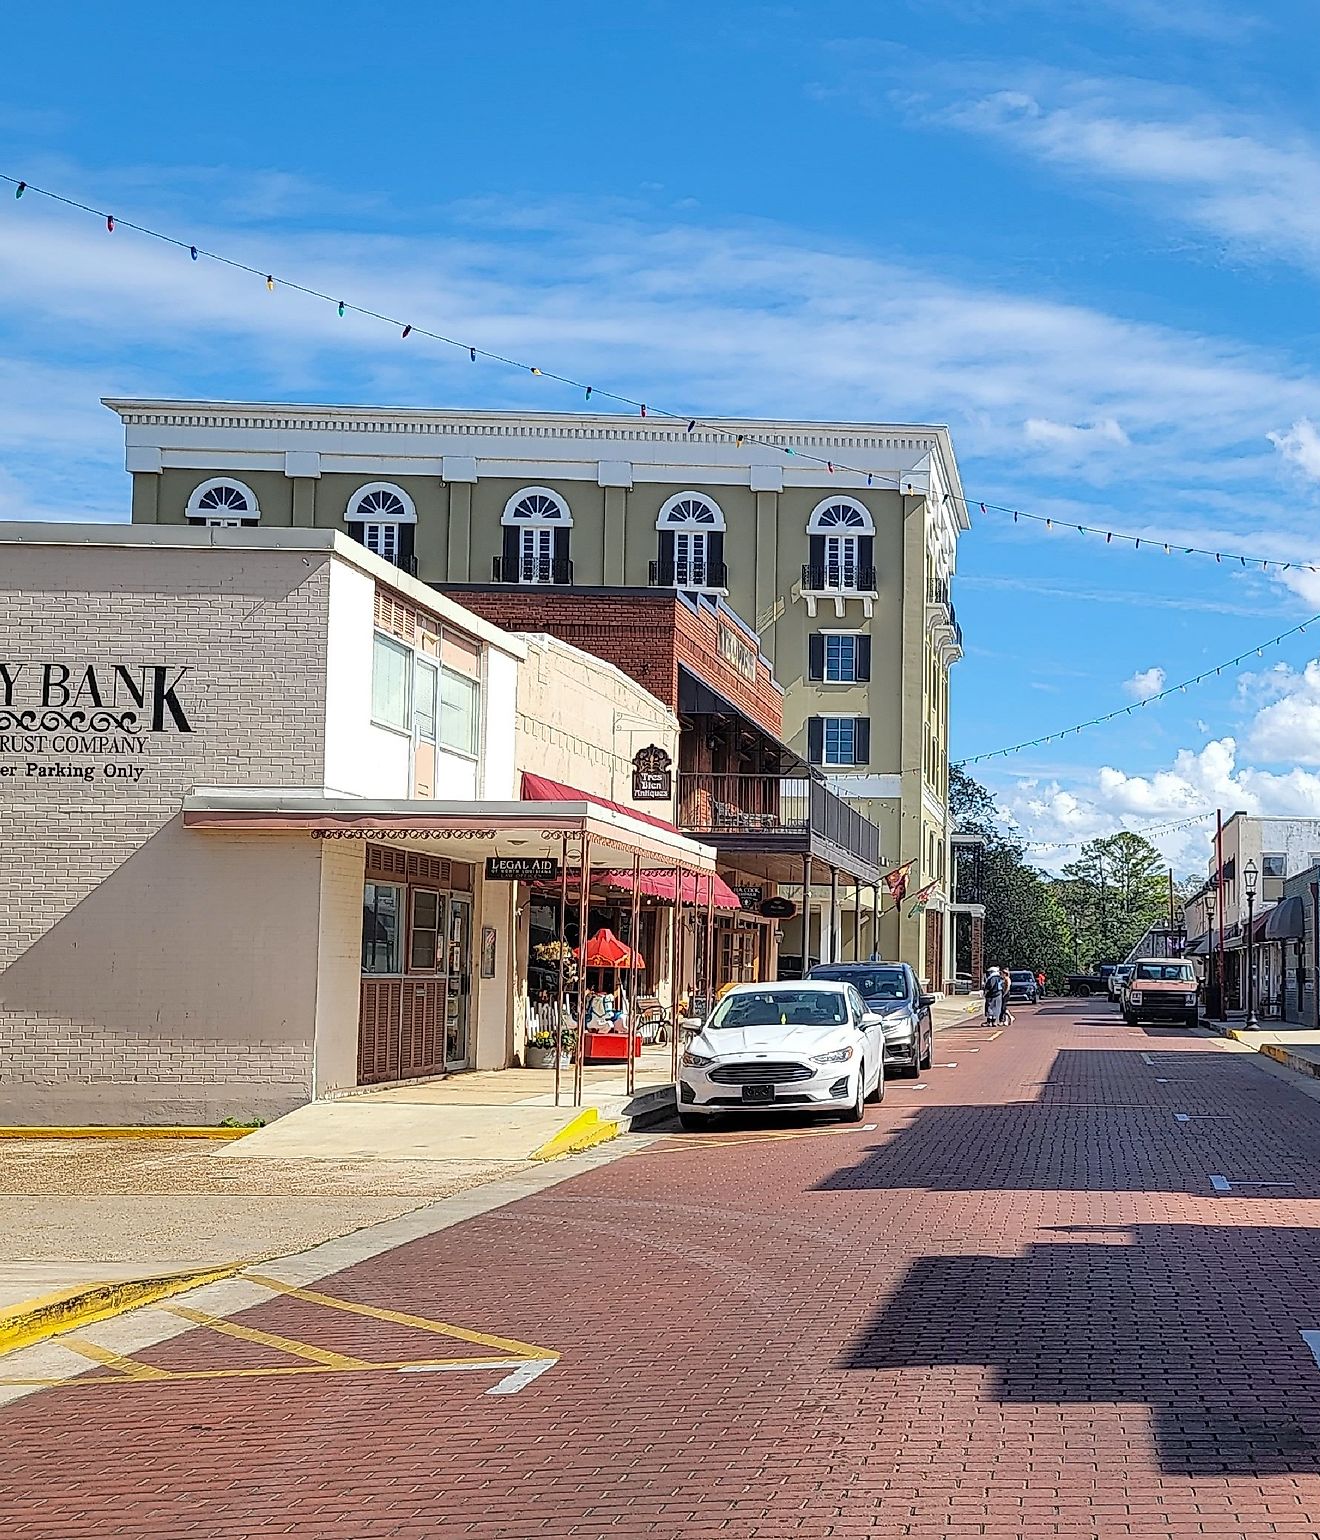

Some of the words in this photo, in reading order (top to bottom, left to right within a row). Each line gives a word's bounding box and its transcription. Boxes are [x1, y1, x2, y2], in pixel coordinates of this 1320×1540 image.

[36, 663, 197, 733] BANK
[52, 736, 149, 754] COMPANY
[26, 763, 95, 782] Parking
[104, 763, 145, 782] Only
